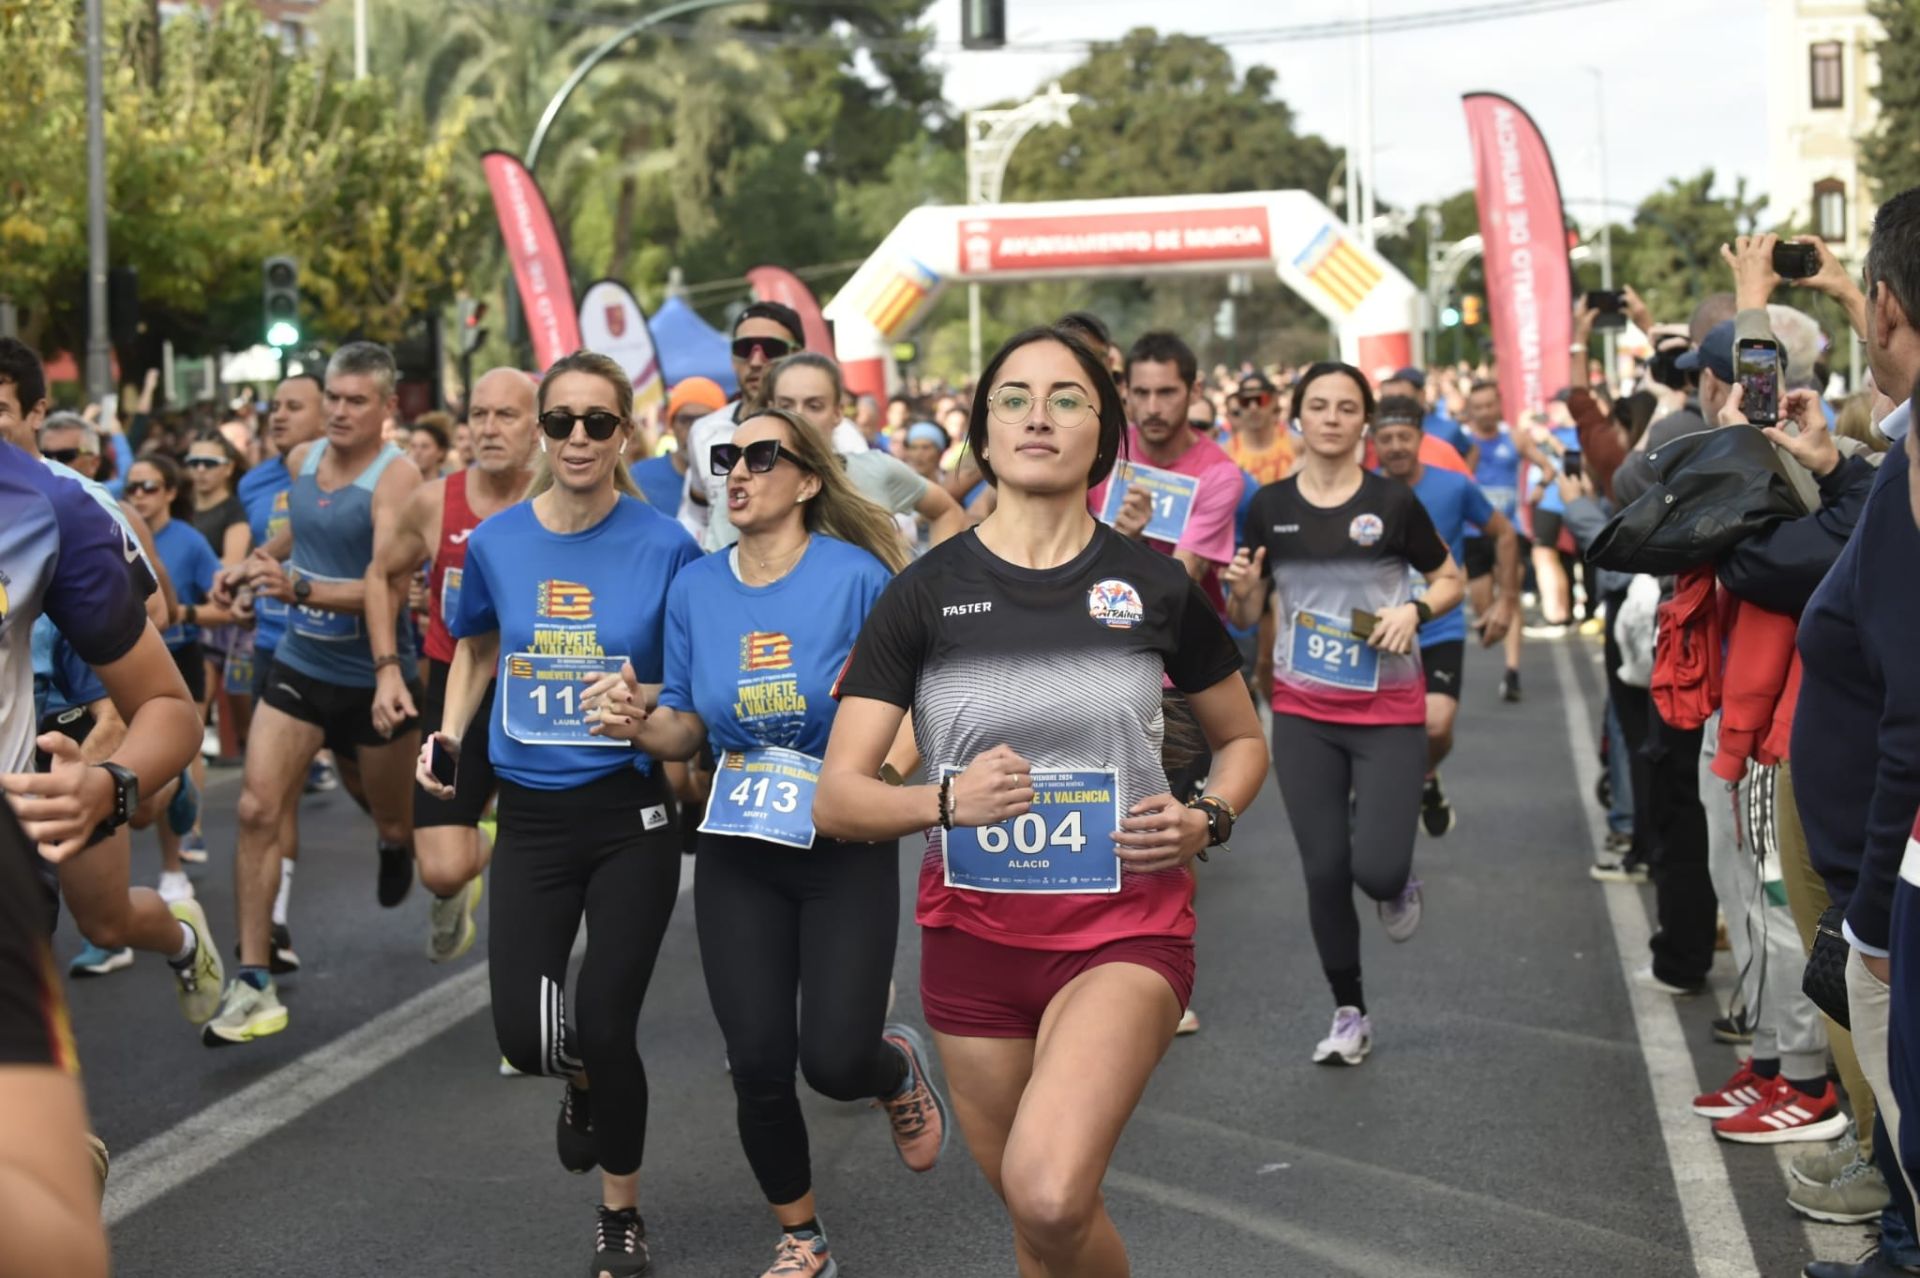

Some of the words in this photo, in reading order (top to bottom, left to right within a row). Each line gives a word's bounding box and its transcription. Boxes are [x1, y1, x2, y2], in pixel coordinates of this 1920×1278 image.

[1000, 232, 1152, 257] AYUNTAMIENTO
[1155, 230, 1180, 249] DE
[1183, 226, 1262, 248] MURCIA
[942, 601, 992, 617] FASTER
[1308, 634, 1360, 668] 921
[733, 703, 744, 718] X
[746, 695, 807, 717] VALENCIA
[729, 777, 799, 813] 413
[1043, 792, 1051, 804] X
[1054, 790, 1110, 804] VALENCIA
[976, 810, 1087, 854] 604
[1008, 859, 1050, 869] ALACID
